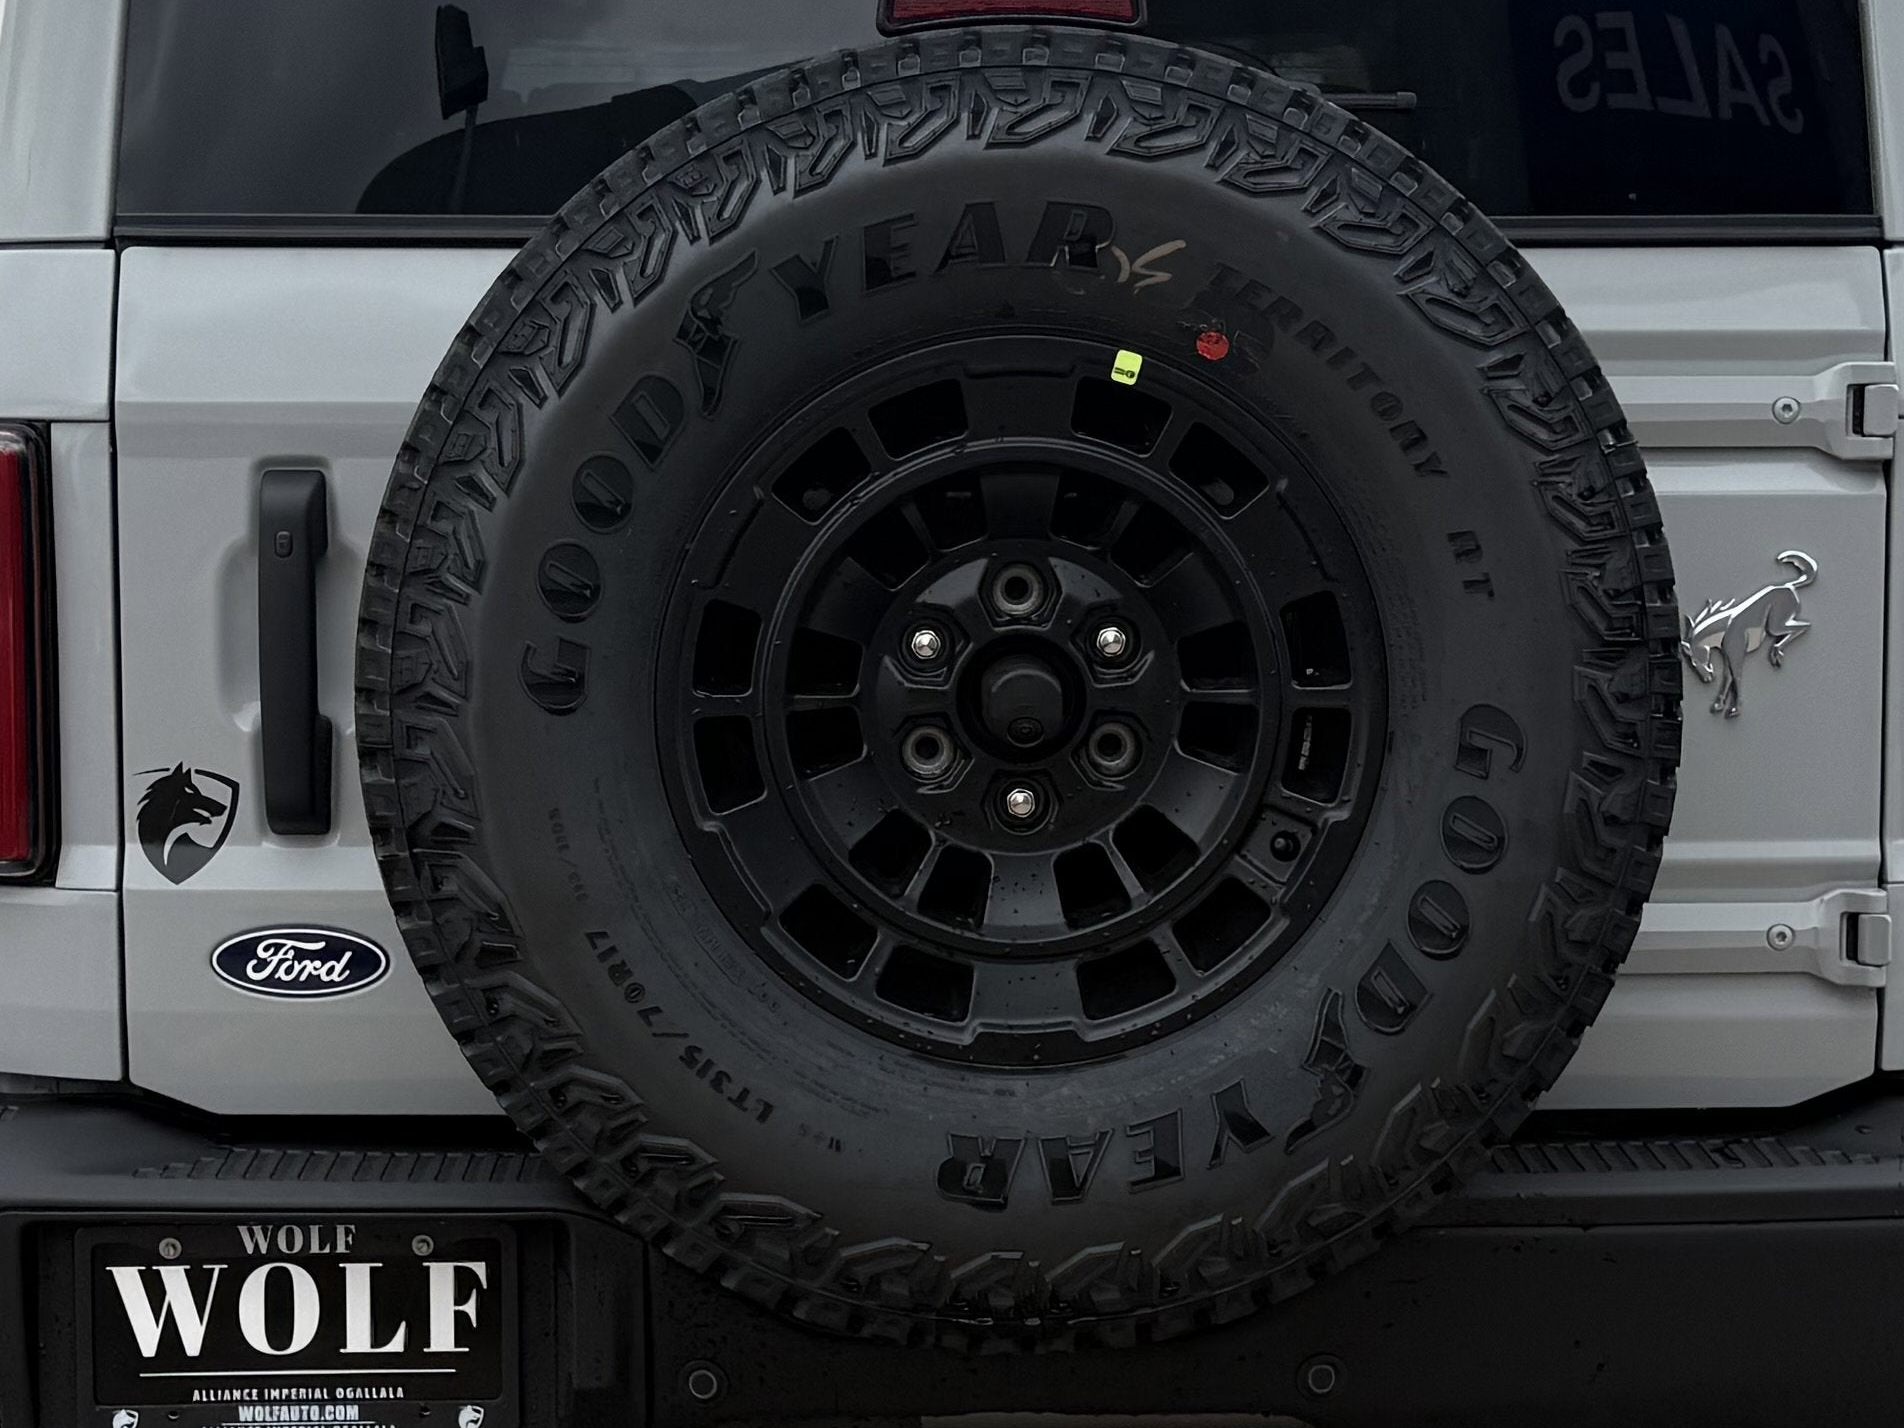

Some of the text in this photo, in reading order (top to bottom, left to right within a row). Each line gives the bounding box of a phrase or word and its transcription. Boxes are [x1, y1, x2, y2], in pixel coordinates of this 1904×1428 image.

[1207, 261, 1452, 481] TERRITORY
[246, 938, 352, 982] Ford
[584, 928, 775, 1126] LT315/70R17
[237, 1224, 357, 1255] WOLF
[106, 1261, 488, 1358] WOLF
[193, 1386, 404, 1402] ALLIANCE IMPERIAL OGALLALA
[238, 1404, 359, 1422] WOLFAUTO.COM
